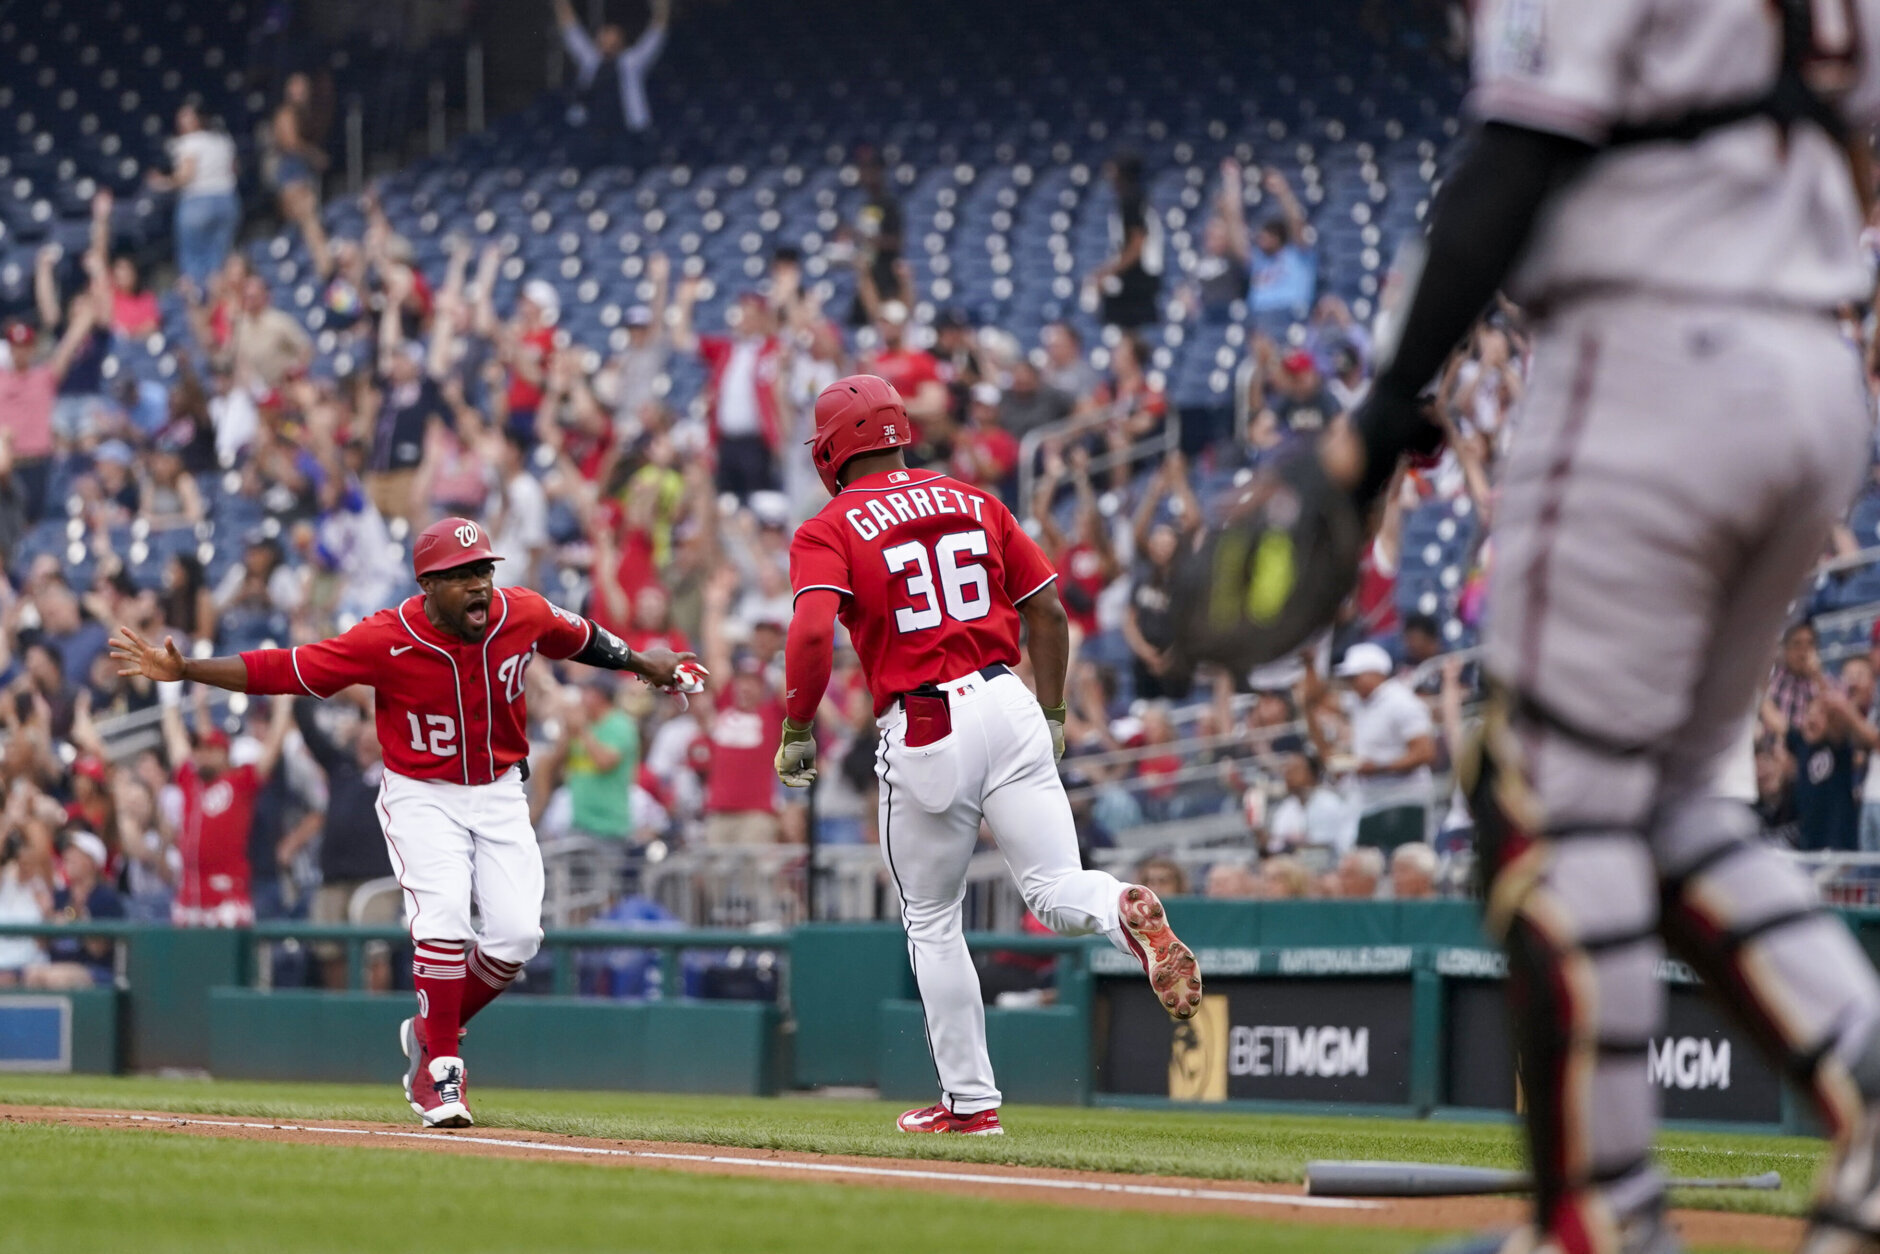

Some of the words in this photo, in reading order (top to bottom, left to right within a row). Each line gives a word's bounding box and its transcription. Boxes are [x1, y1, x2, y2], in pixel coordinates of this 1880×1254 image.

[883, 424, 896, 436] 36
[454, 522, 479, 548] W
[845, 486, 985, 542] GARRETT
[882, 529, 991, 634] 36
[406, 710, 458, 757] 12
[1229, 1025, 1369, 1078] BETMGM
[1646, 1036, 1732, 1090] MGM
